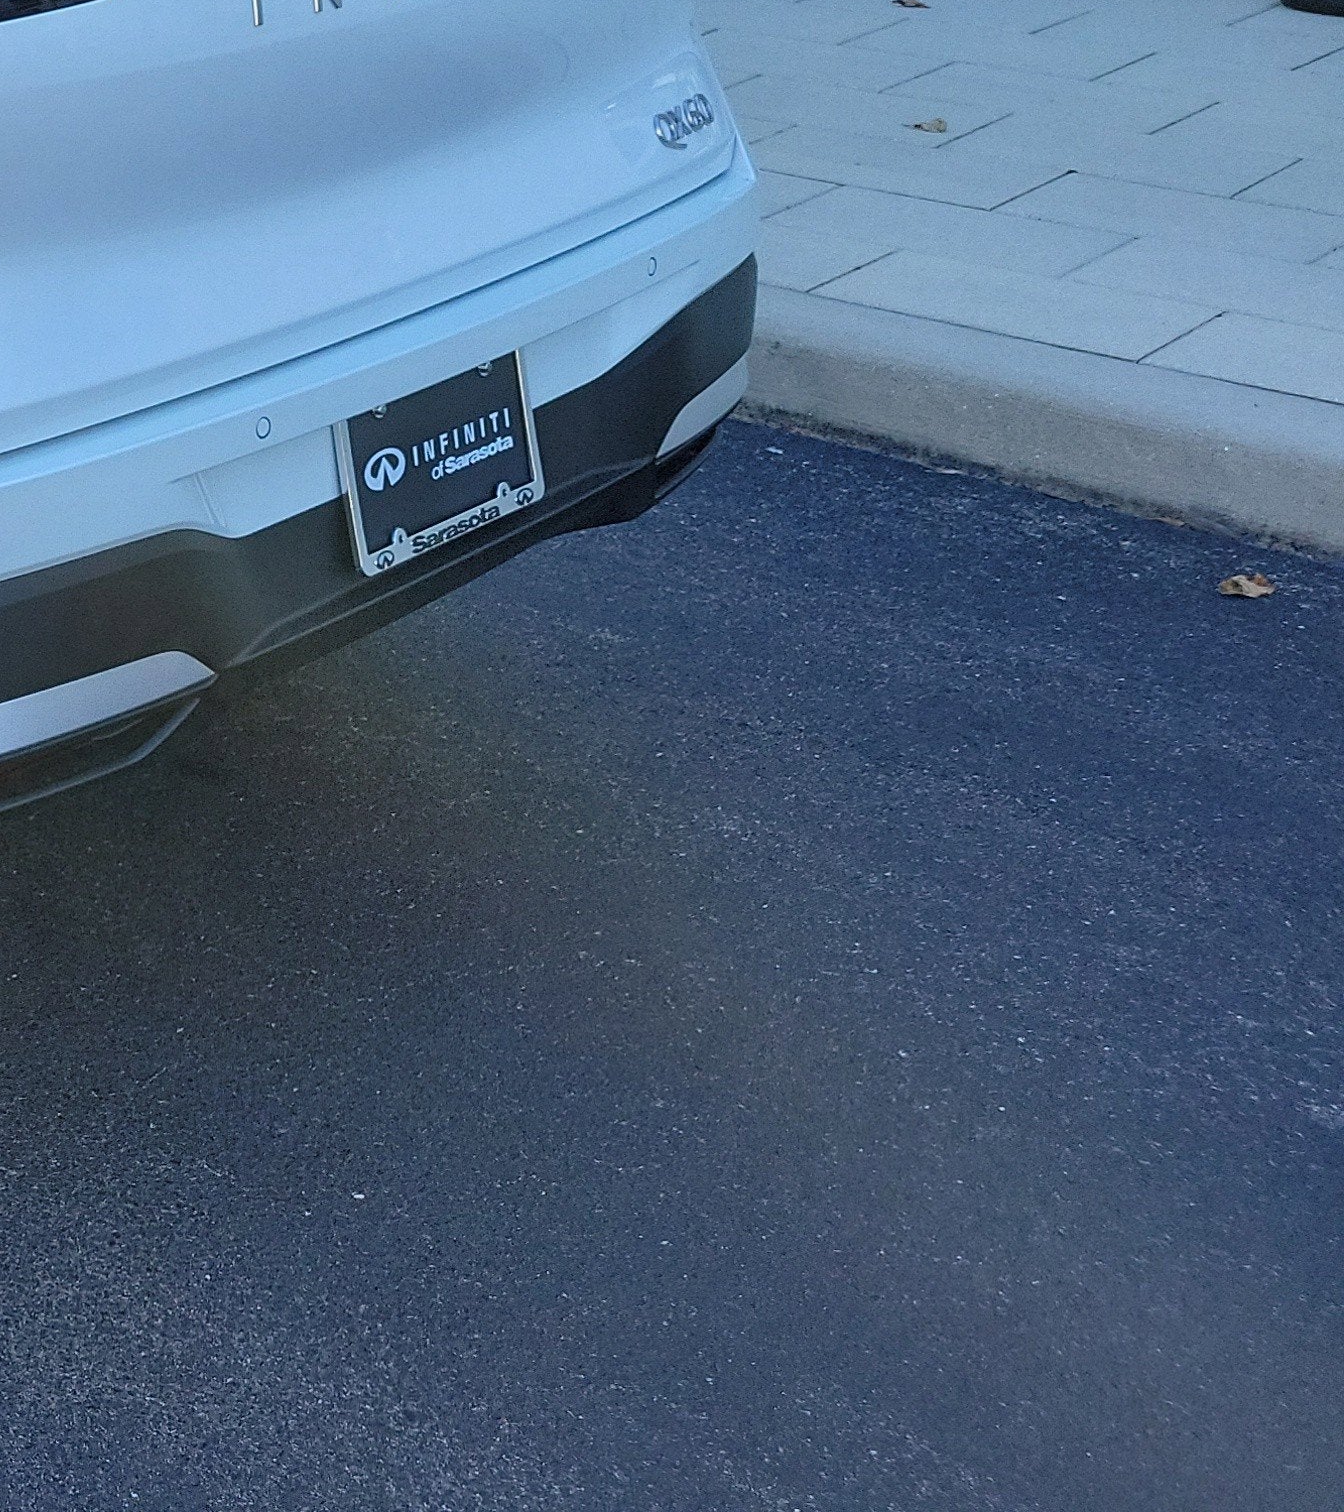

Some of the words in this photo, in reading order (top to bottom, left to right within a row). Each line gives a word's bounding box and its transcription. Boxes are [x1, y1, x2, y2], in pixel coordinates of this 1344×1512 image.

[652, 92, 715, 151] QX60
[412, 407, 510, 466] INFINITI
[431, 462, 446, 480] of
[444, 434, 514, 474] Sarasota
[412, 505, 500, 553] Sarasota
